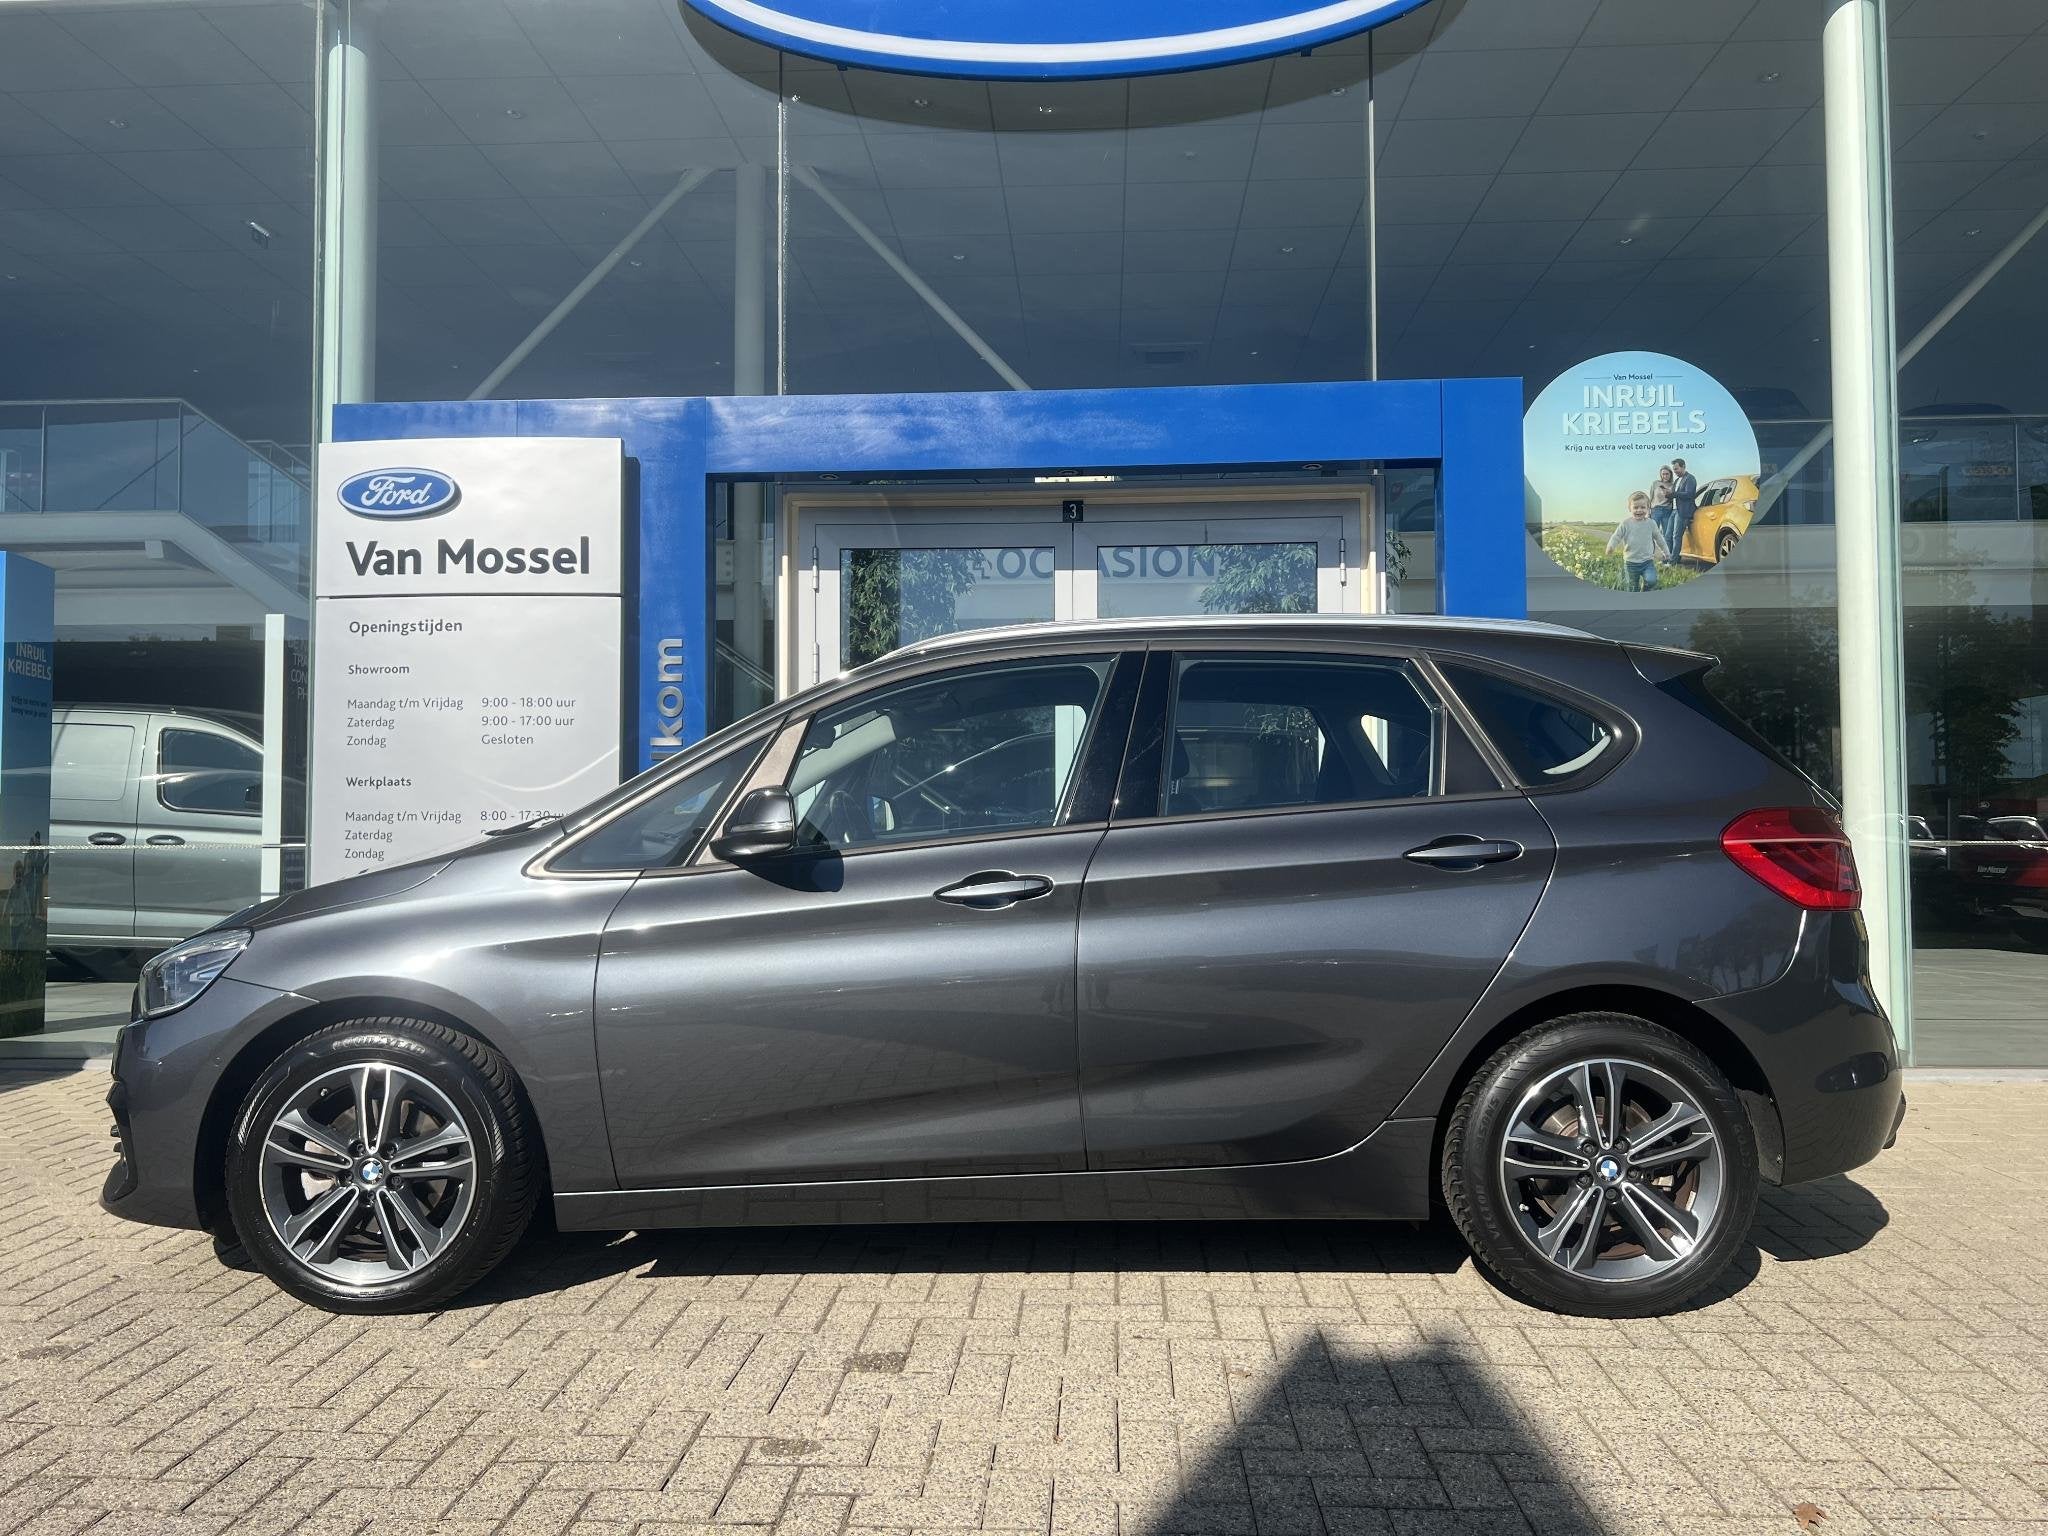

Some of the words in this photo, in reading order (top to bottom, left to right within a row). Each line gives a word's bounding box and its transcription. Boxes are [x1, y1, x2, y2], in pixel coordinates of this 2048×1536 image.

[1583, 384, 1684, 408] INRUIL
[1562, 409, 1707, 435] KRIEBELS
[1565, 444, 1582, 452] Krijg
[1596, 443, 1616, 451] extra
[1635, 443, 1656, 452] terug
[361, 475, 432, 506] Ford
[1069, 503, 1077, 519] 3
[346, 540, 422, 576] Van
[438, 536, 589, 574] Mossel
[349, 619, 463, 637] Openingstijden
[15, 642, 47, 663] INRUIL
[8, 657, 52, 681] KRIEBELS
[348, 664, 410, 675] Showroom
[347, 698, 396, 711] Maandag
[399, 697, 420, 709] t/m
[422, 697, 464, 711] Vrijdag
[481, 697, 508, 708] 9:00
[520, 697, 553, 708] 18:00
[556, 699, 576, 708] uur
[347, 717, 395, 729] Zaterdag
[481, 715, 508, 726] 9:00
[519, 715, 552, 726] 17:00
[555, 717, 575, 726] uur
[346, 735, 387, 748] Zondag
[481, 734, 534, 745] Gesloten
[346, 776, 412, 789] Werkplaats
[345, 811, 394, 824] Maandag
[397, 811, 418, 822] t/m
[420, 811, 462, 824] Vrijdag
[480, 810, 507, 821] 8:00
[344, 829, 393, 842] Zaterdag
[344, 848, 386, 861] Zondag
